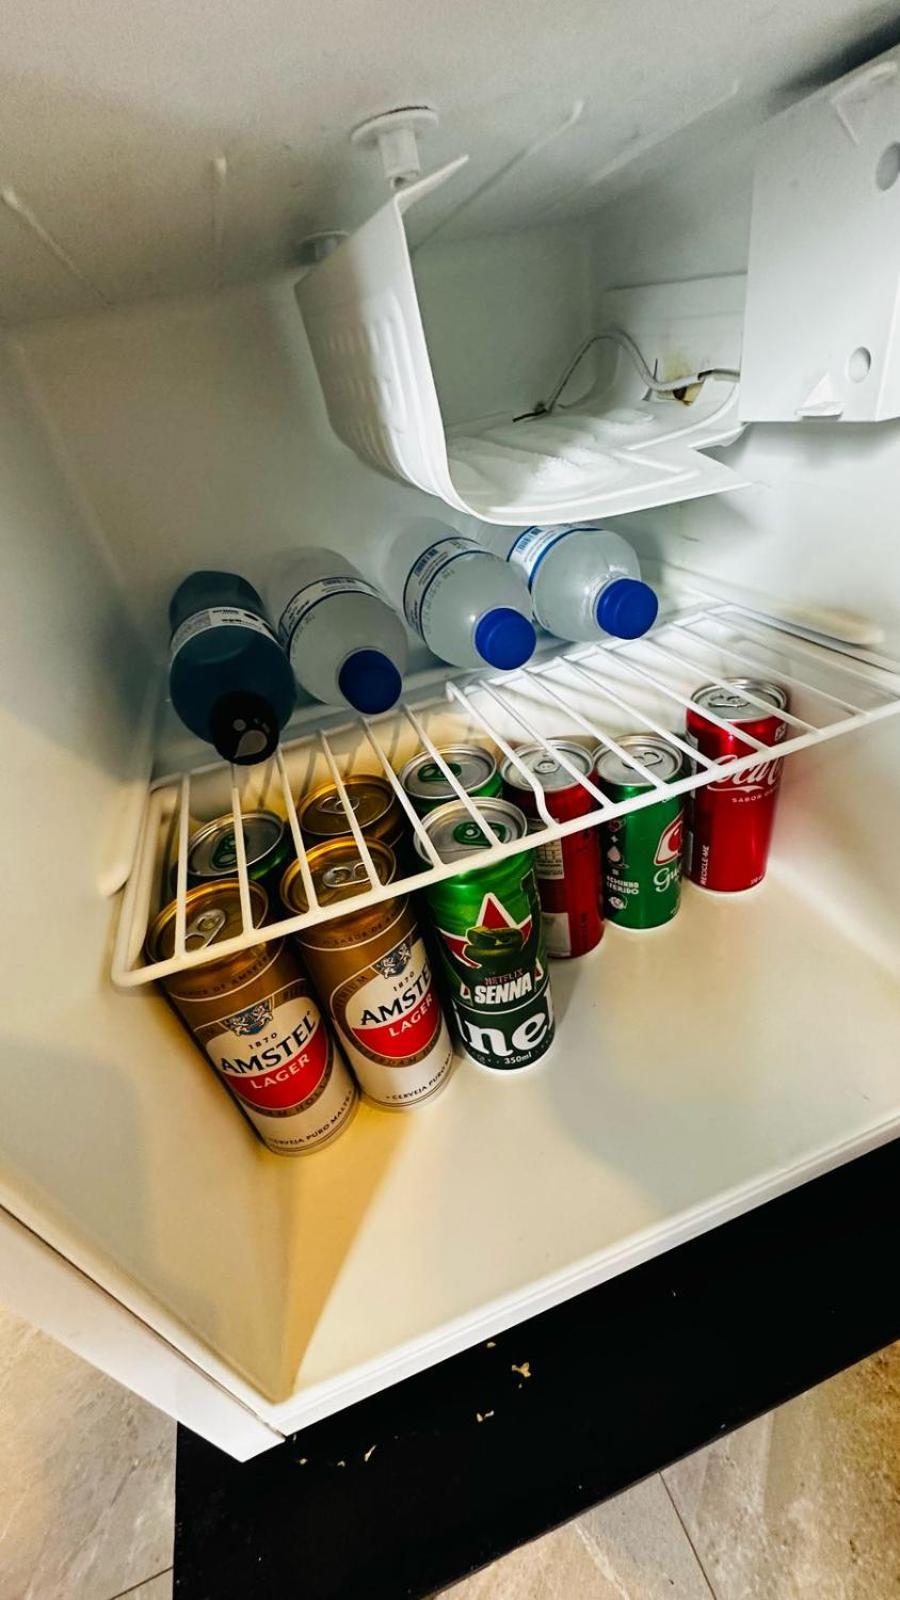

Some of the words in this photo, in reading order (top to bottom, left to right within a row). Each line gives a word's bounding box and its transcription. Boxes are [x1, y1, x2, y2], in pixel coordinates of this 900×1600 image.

[393, 971, 415, 992] 1870
[484, 967, 524, 985] NETFLIX
[474, 972, 532, 1004] SENNA
[388, 993, 433, 1037] LAGER
[221, 1015, 316, 1074] AMSTEL
[248, 1032, 277, 1049] 1870
[504, 1051, 532, 1064] 350ml
[250, 1054, 310, 1089] LAGER
[306, 1123, 330, 1140] PURO
